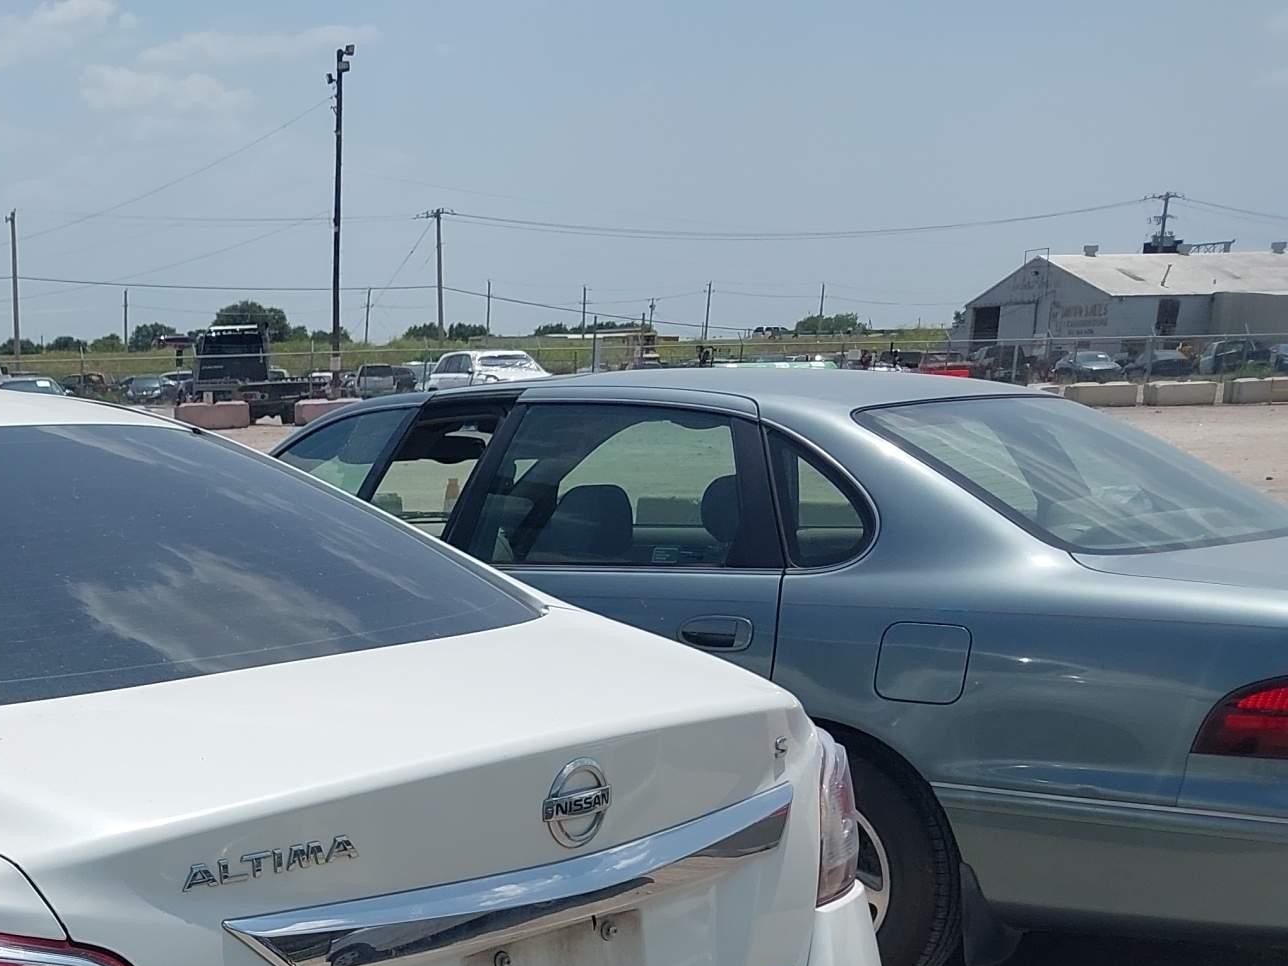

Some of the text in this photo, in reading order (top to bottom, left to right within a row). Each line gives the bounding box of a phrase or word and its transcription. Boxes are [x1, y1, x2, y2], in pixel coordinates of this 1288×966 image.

[774, 735, 788, 759] S
[555, 789, 610, 816] NISSAN
[182, 834, 361, 892] ALTIMA
